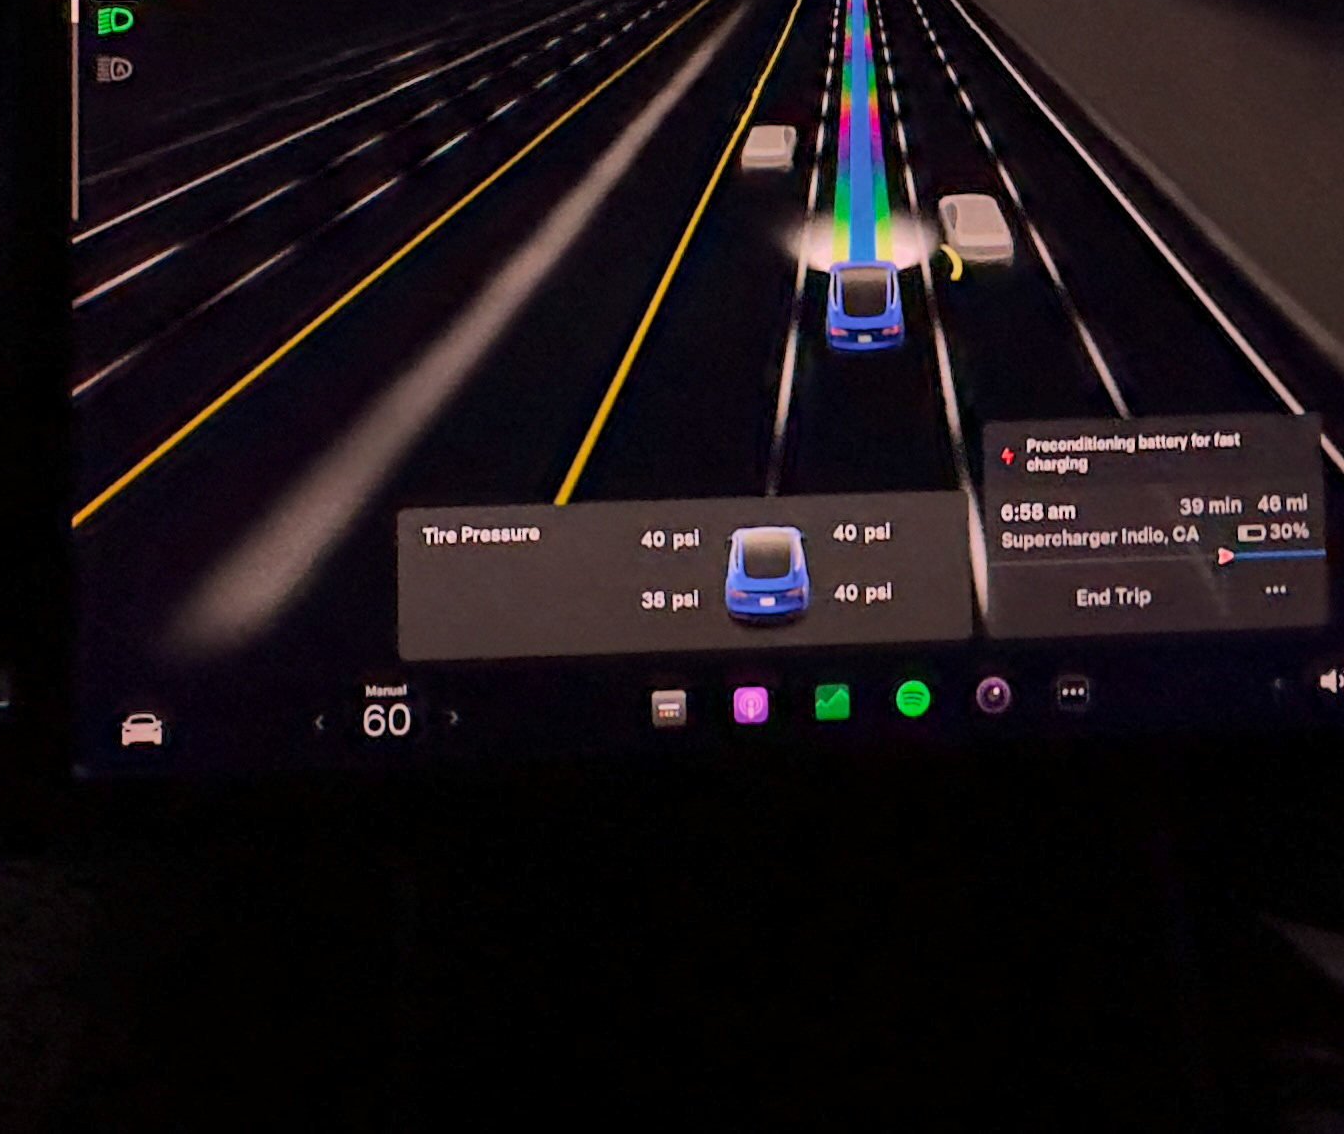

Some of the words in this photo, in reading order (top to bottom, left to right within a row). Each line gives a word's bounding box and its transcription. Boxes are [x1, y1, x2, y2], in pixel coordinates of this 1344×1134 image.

[1026, 435, 1136, 454] Preconditioning
[1138, 434, 1189, 451] battery
[1191, 432, 1211, 448] for
[1214, 432, 1241, 448] fast
[1026, 455, 1089, 474] charging
[1001, 503, 1044, 522] 6:58
[1047, 505, 1076, 520] am
[1179, 497, 1204, 516] 39
[1208, 496, 1242, 515] min
[1257, 495, 1283, 513] 46
[1287, 493, 1309, 512] mi
[423, 526, 458, 547] Tire
[461, 524, 541, 545] Pressure
[641, 530, 666, 549] 40
[672, 528, 699, 551] psi
[833, 524, 858, 542] 40
[864, 522, 891, 546] psi
[1002, 527, 1119, 551] Supercharger
[1122, 526, 1169, 546] Indio,
[1172, 524, 1200, 543] CA
[1269, 522, 1310, 541] 30%
[672, 589, 699, 612] psi
[834, 584, 859, 603] 40
[865, 582, 892, 606] psi
[1076, 587, 1111, 607] End
[1115, 586, 1152, 609] Trip
[365, 684, 408, 697] Manual
[363, 702, 411, 738] 60
